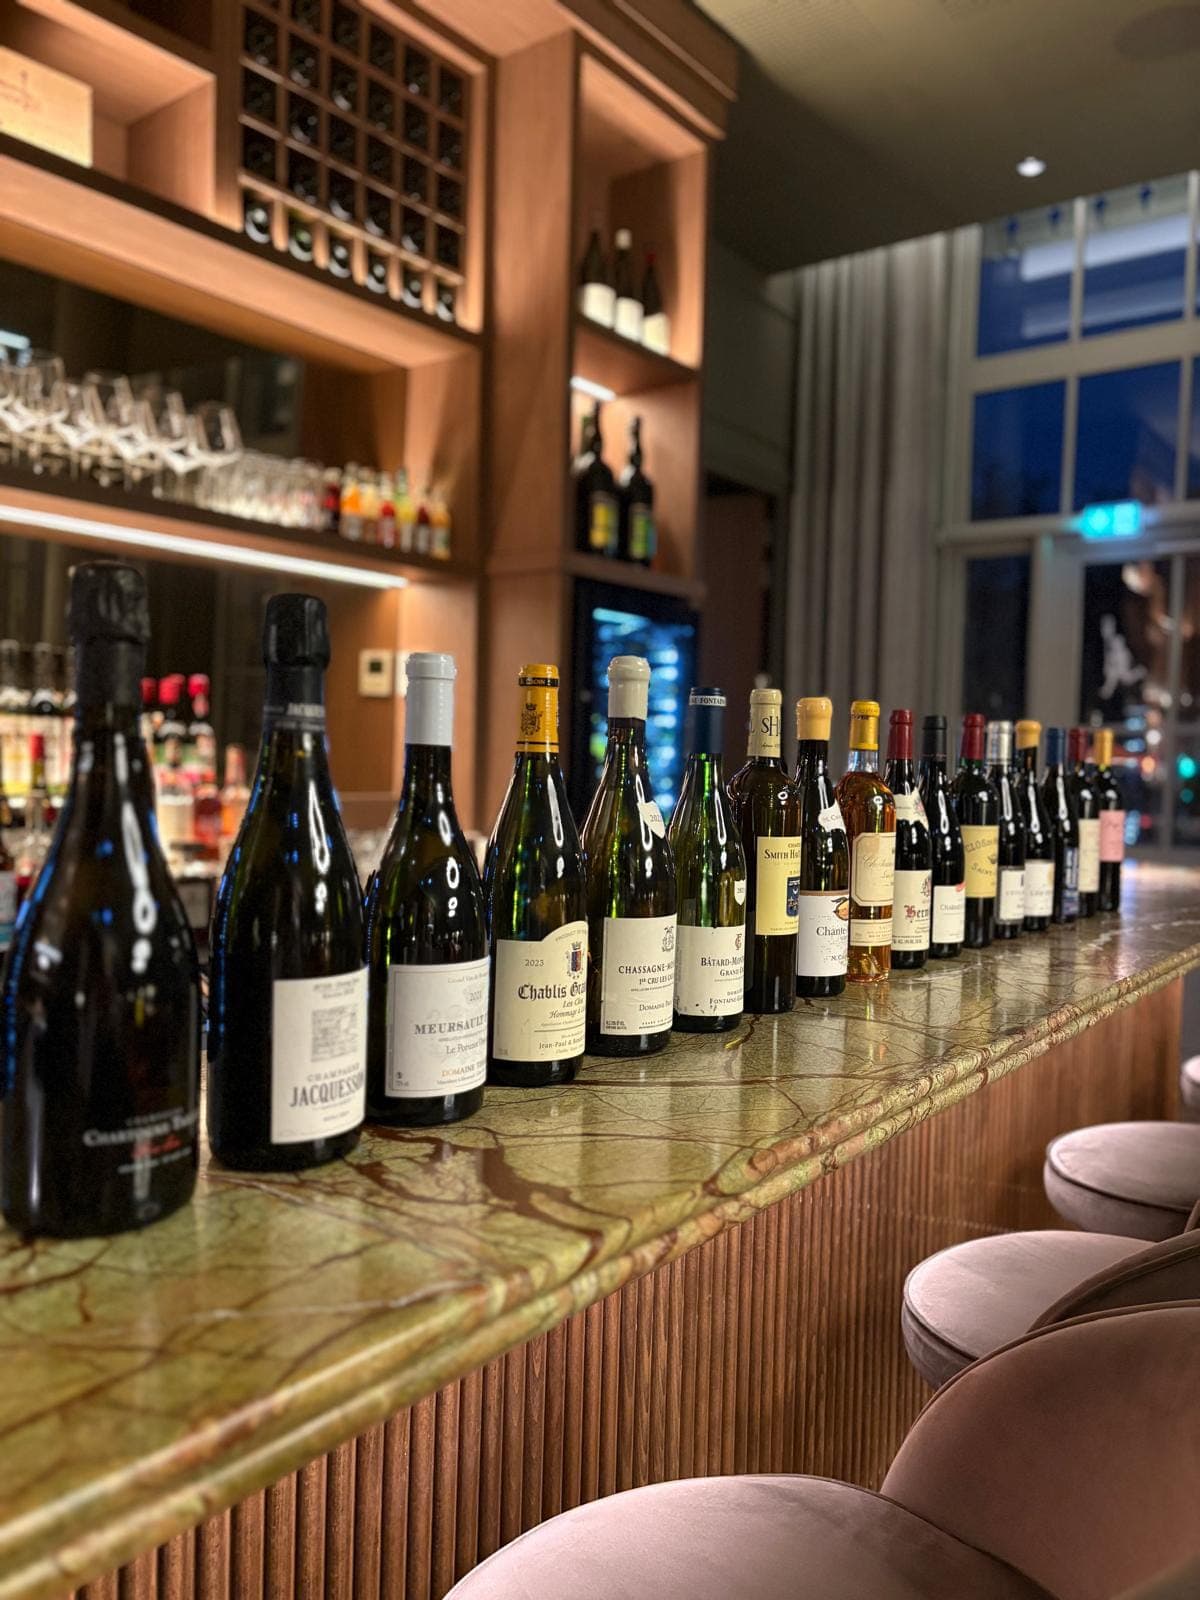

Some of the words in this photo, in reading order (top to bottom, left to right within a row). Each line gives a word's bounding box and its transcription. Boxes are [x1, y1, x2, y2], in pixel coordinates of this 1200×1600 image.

[761, 716, 779, 737] SH
[517, 983, 567, 1002] Chablis
[414, 1015, 484, 1035] MEURSAULT
